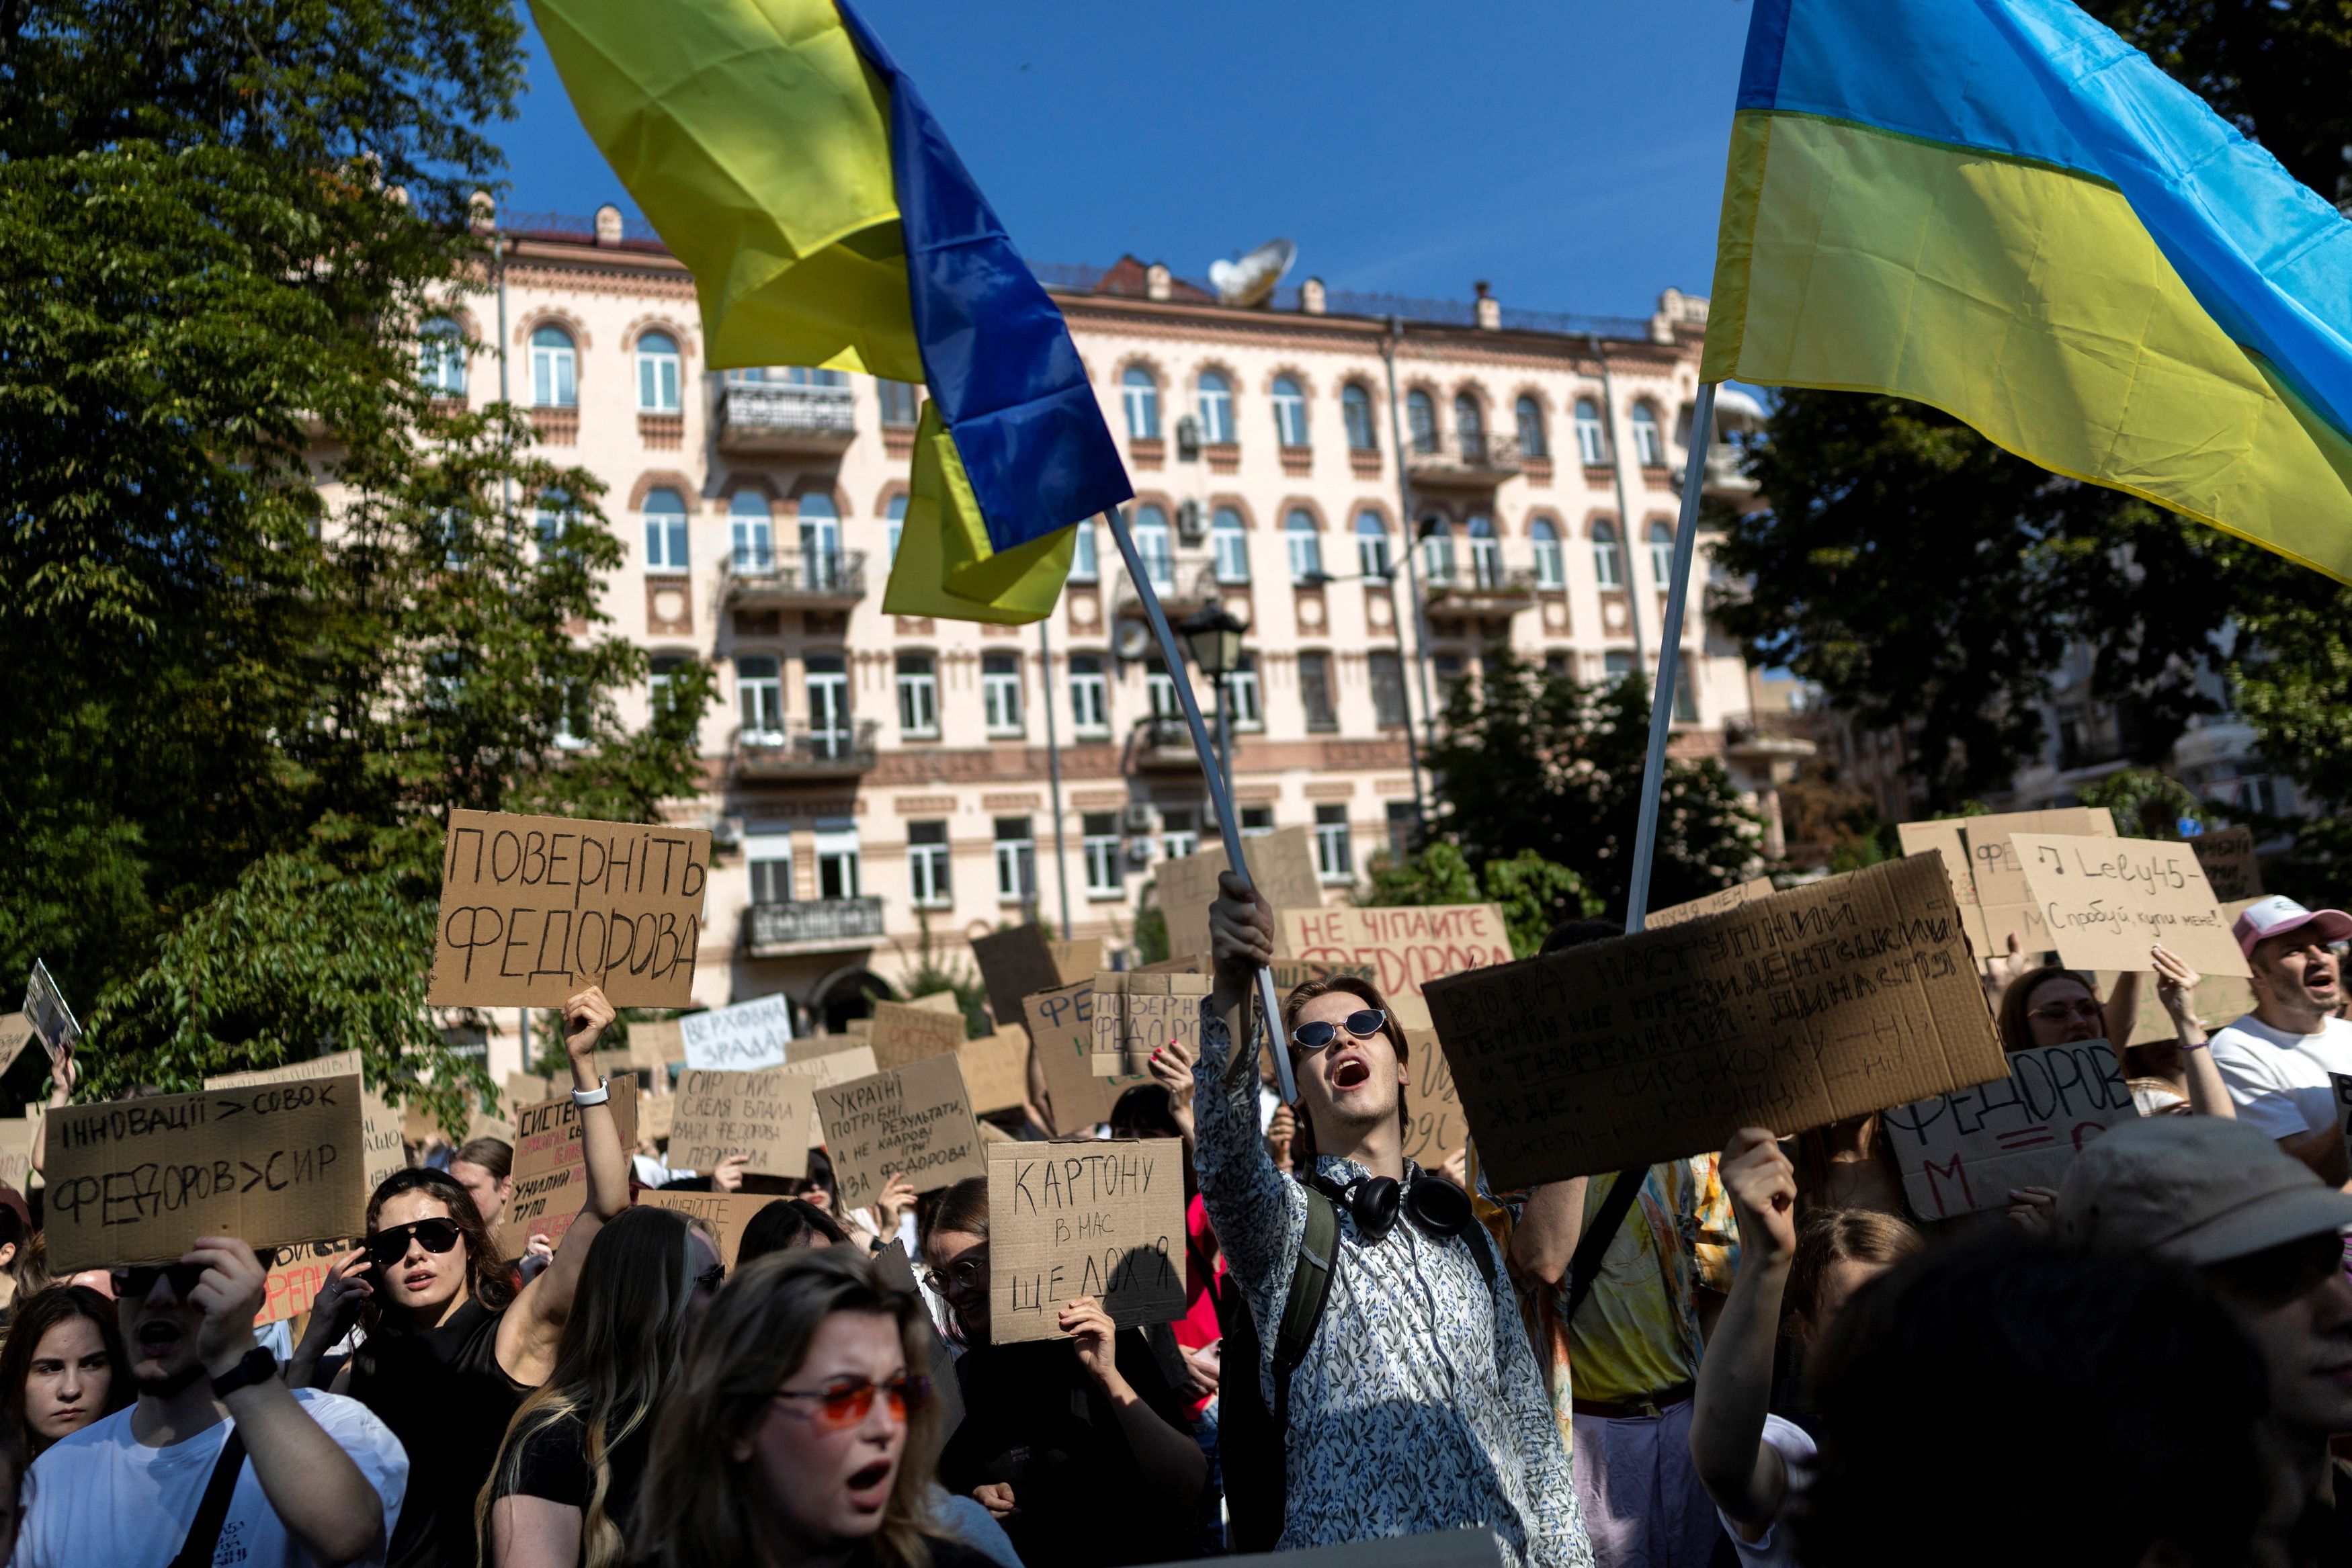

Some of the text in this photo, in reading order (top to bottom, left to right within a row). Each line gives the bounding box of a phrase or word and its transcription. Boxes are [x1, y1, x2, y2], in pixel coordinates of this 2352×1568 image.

[449, 827, 705, 910] ПОВЕРНІТЬ
[445, 906, 698, 993] ФЕДОРОВА
[1300, 912, 1345, 947] НЕ
[1568, 1004, 1613, 1033] НЕ
[61, 1098, 207, 1148] ІННОВАЦІЇ
[253, 1084, 339, 1116] СОВОК
[830, 1074, 903, 1118] УКРАЇНІ
[831, 1100, 902, 1140] ПОТРІБНІ
[853, 1143, 871, 1160] НЕ
[1014, 1154, 1154, 1216] КАРТОНУ
[1056, 1212, 1114, 1248] В НАС
[1012, 1265, 1064, 1317] ЩЕ
